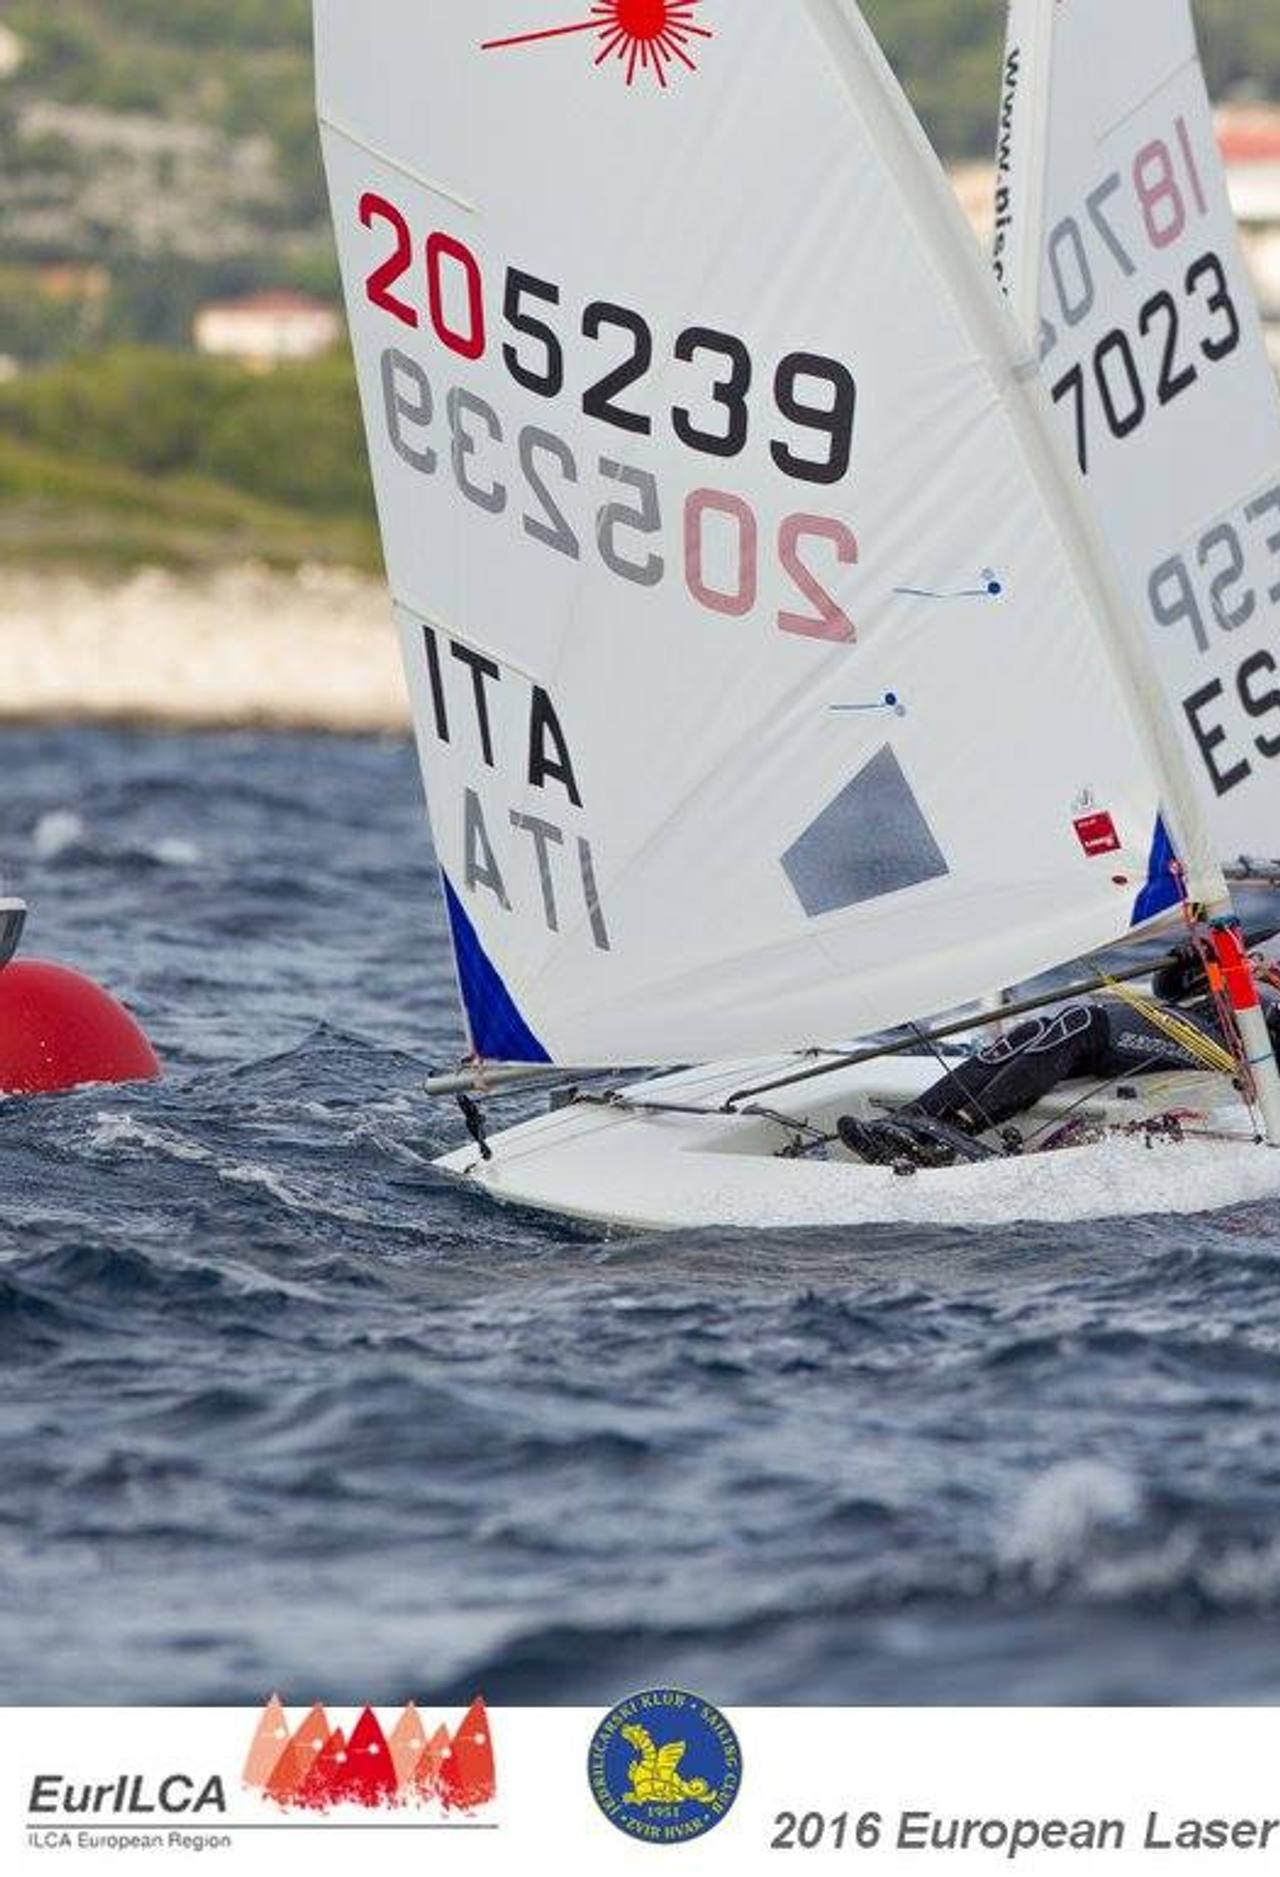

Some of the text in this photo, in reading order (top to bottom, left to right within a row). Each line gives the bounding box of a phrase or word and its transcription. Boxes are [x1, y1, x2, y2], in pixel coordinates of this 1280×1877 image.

[358, 191, 858, 485] 205239
[1050, 251, 1241, 476] 7023
[422, 624, 584, 809] ITA
